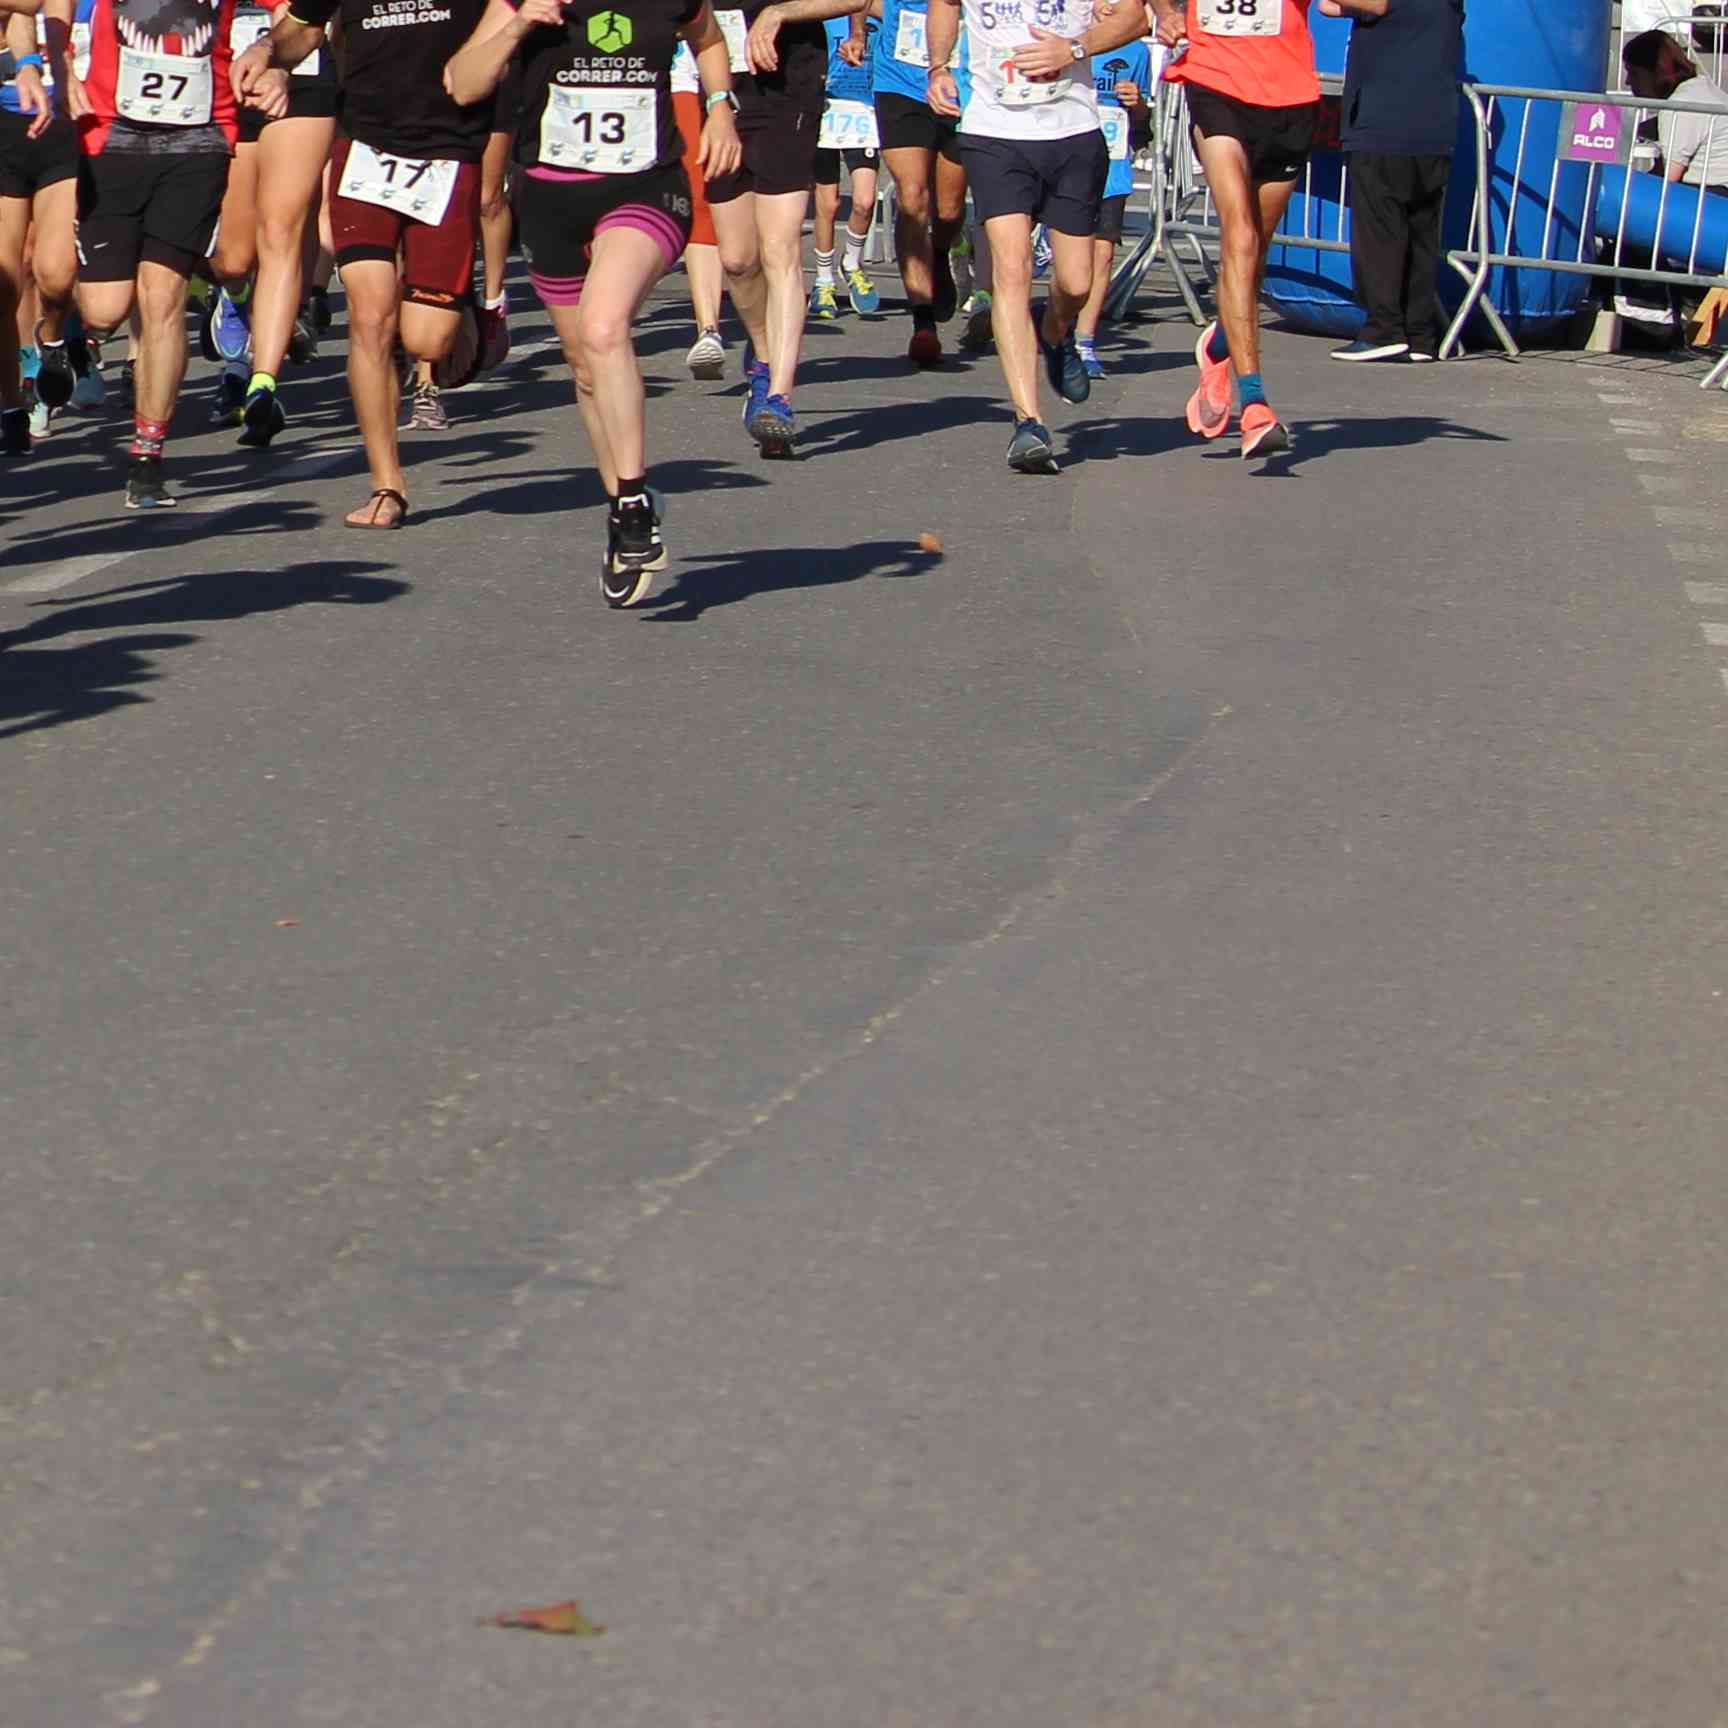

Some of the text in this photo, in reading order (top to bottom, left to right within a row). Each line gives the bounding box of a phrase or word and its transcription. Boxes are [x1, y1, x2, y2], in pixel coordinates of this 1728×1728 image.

[362, 8, 452, 30] CORRER.COM
[141, 73, 189, 100] 27
[556, 70, 658, 83] CORRER.COM
[572, 112, 626, 144] 13
[823, 112, 871, 134] 176
[380, 159, 433, 189] 17
